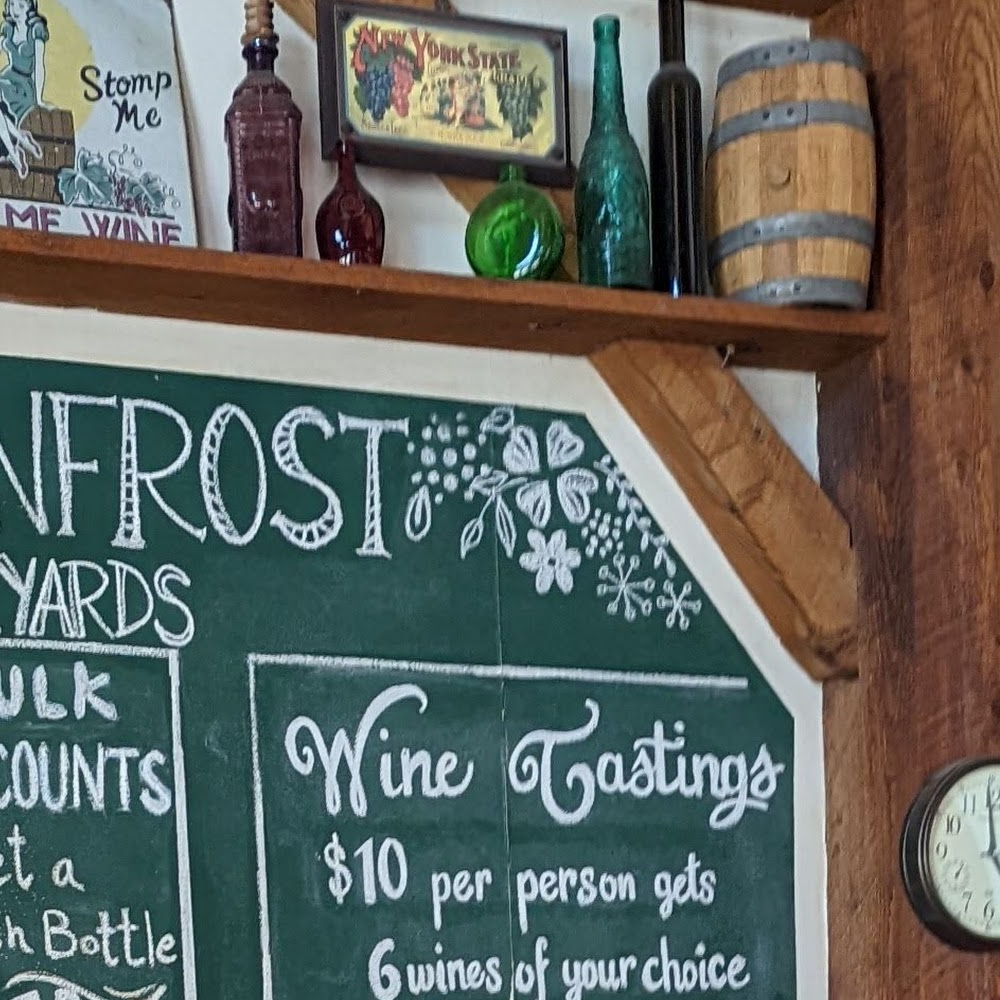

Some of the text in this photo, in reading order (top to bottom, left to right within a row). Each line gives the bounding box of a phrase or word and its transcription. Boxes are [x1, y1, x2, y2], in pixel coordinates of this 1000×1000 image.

[80, 65, 172, 102] Stomp
[112, 98, 162, 133] Me
[285, 684, 786, 831] Wine Tastings
[946, 814, 961, 835] 10
[936, 841, 948, 860] 9
[51, 860, 86, 892] a
[326, 831, 717, 934] $10 per person gets
[963, 891, 973, 914] 7
[41, 908, 177, 969] Bottle
[406, 946, 502, 996] wines
[641, 936, 751, 994] choice
